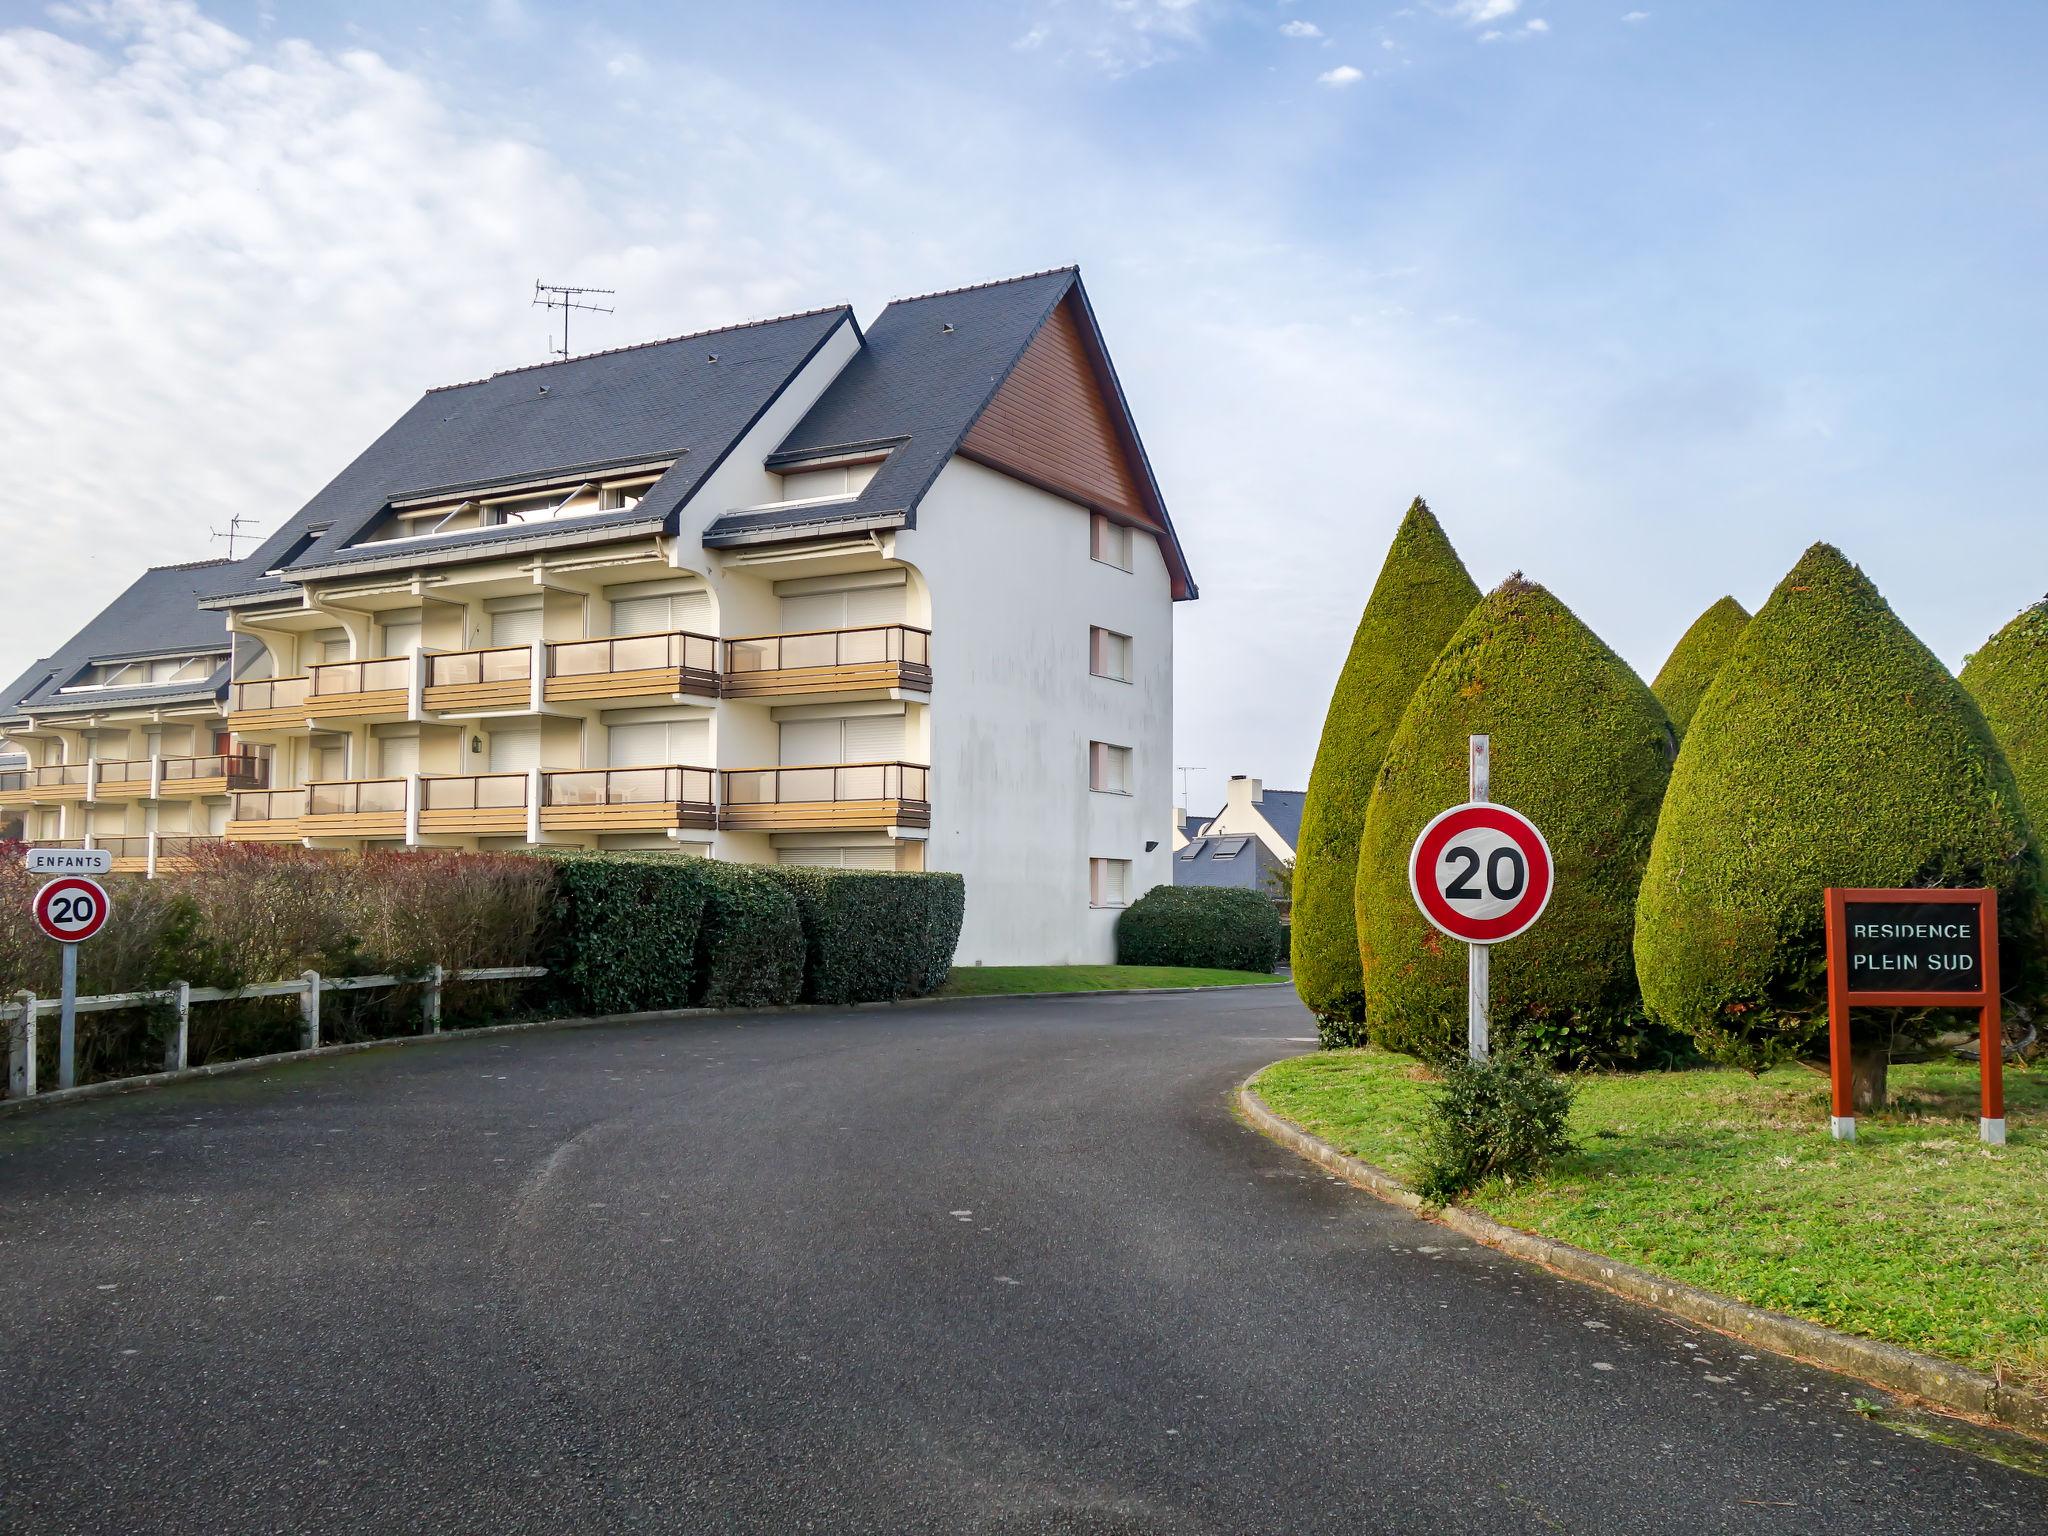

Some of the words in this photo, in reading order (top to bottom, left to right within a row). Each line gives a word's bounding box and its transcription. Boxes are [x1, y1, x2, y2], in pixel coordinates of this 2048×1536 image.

[37, 857, 101, 867] ENFANTS
[1445, 846, 1525, 901] 20
[52, 896, 93, 924] 20
[1854, 924, 1971, 938] RESIDENCE
[1854, 954, 1918, 970] PLEIN
[1928, 954, 1973, 970] SUD
